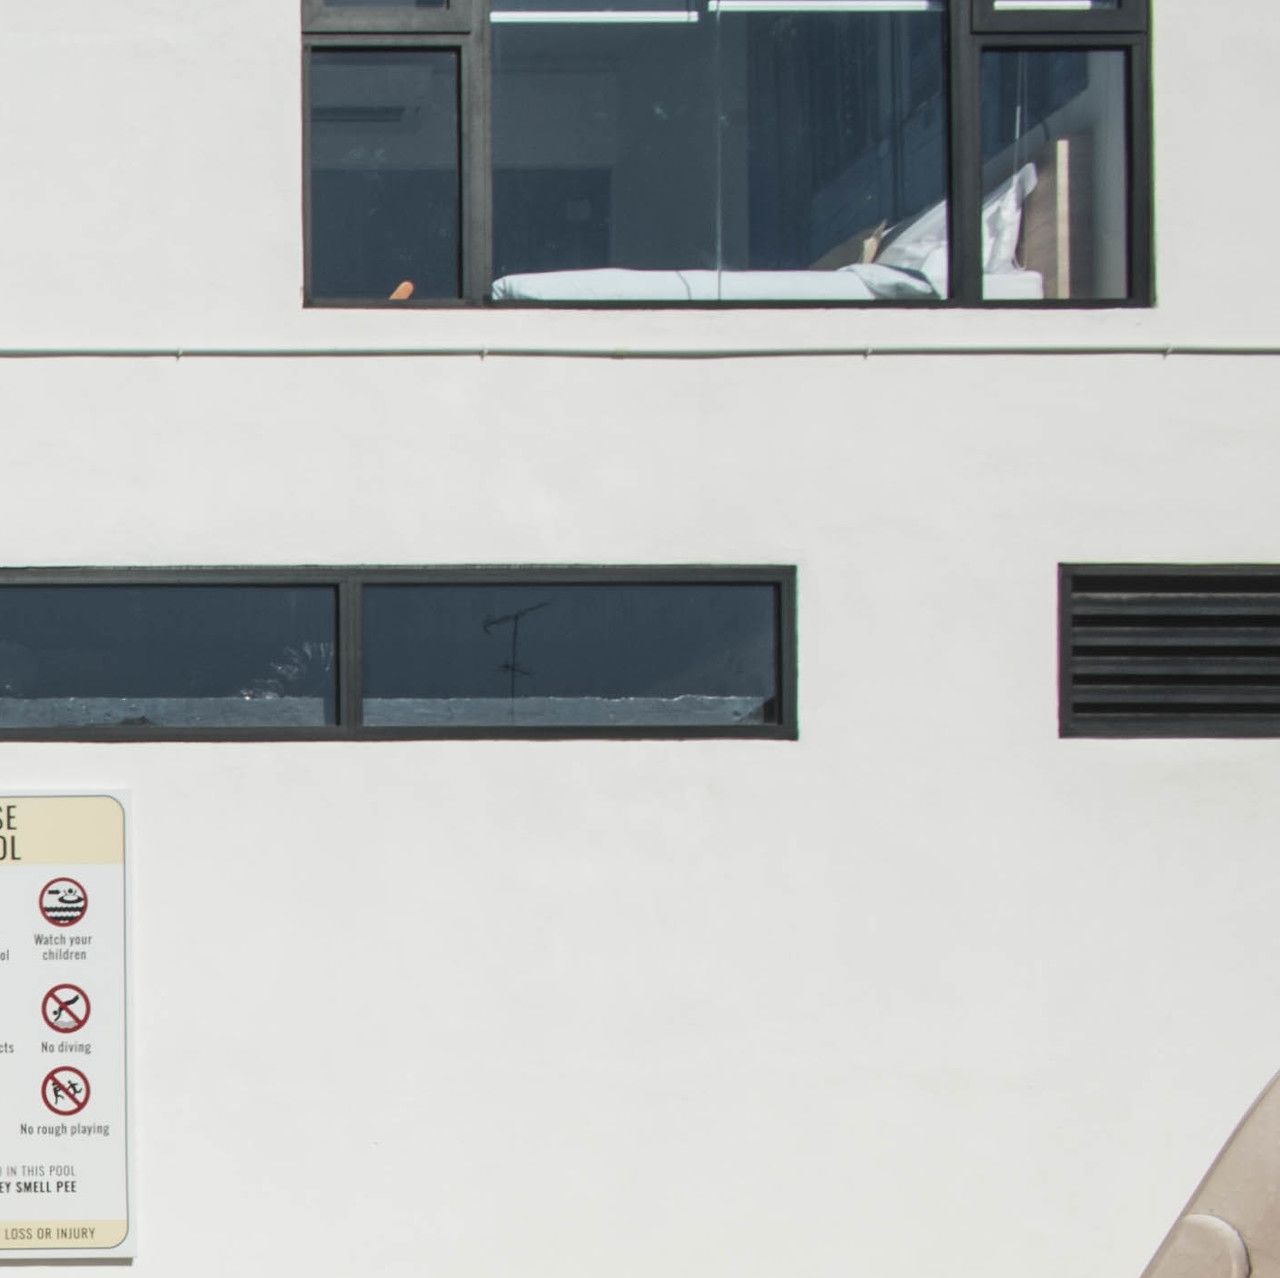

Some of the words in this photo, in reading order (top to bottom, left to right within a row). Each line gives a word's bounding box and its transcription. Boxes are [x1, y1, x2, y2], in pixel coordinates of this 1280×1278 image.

[34, 934, 66, 948] Watch
[69, 936, 92, 947] your
[42, 949, 86, 960] children
[41, 1042, 54, 1053] No
[58, 1041, 91, 1055] diving
[21, 1124, 33, 1135] No
[37, 1123, 67, 1136] rough
[70, 1123, 109, 1136] playing
[7, 1166, 17, 1176] IN
[22, 1165, 45, 1177] THIS
[49, 1165, 75, 1177] POOL
[16, 1181, 51, 1193] SMELL
[57, 1181, 76, 1192] PEE
[5, 1228, 33, 1240] LOSS
[37, 1228, 52, 1239] OR
[57, 1227, 95, 1239] INJURY
